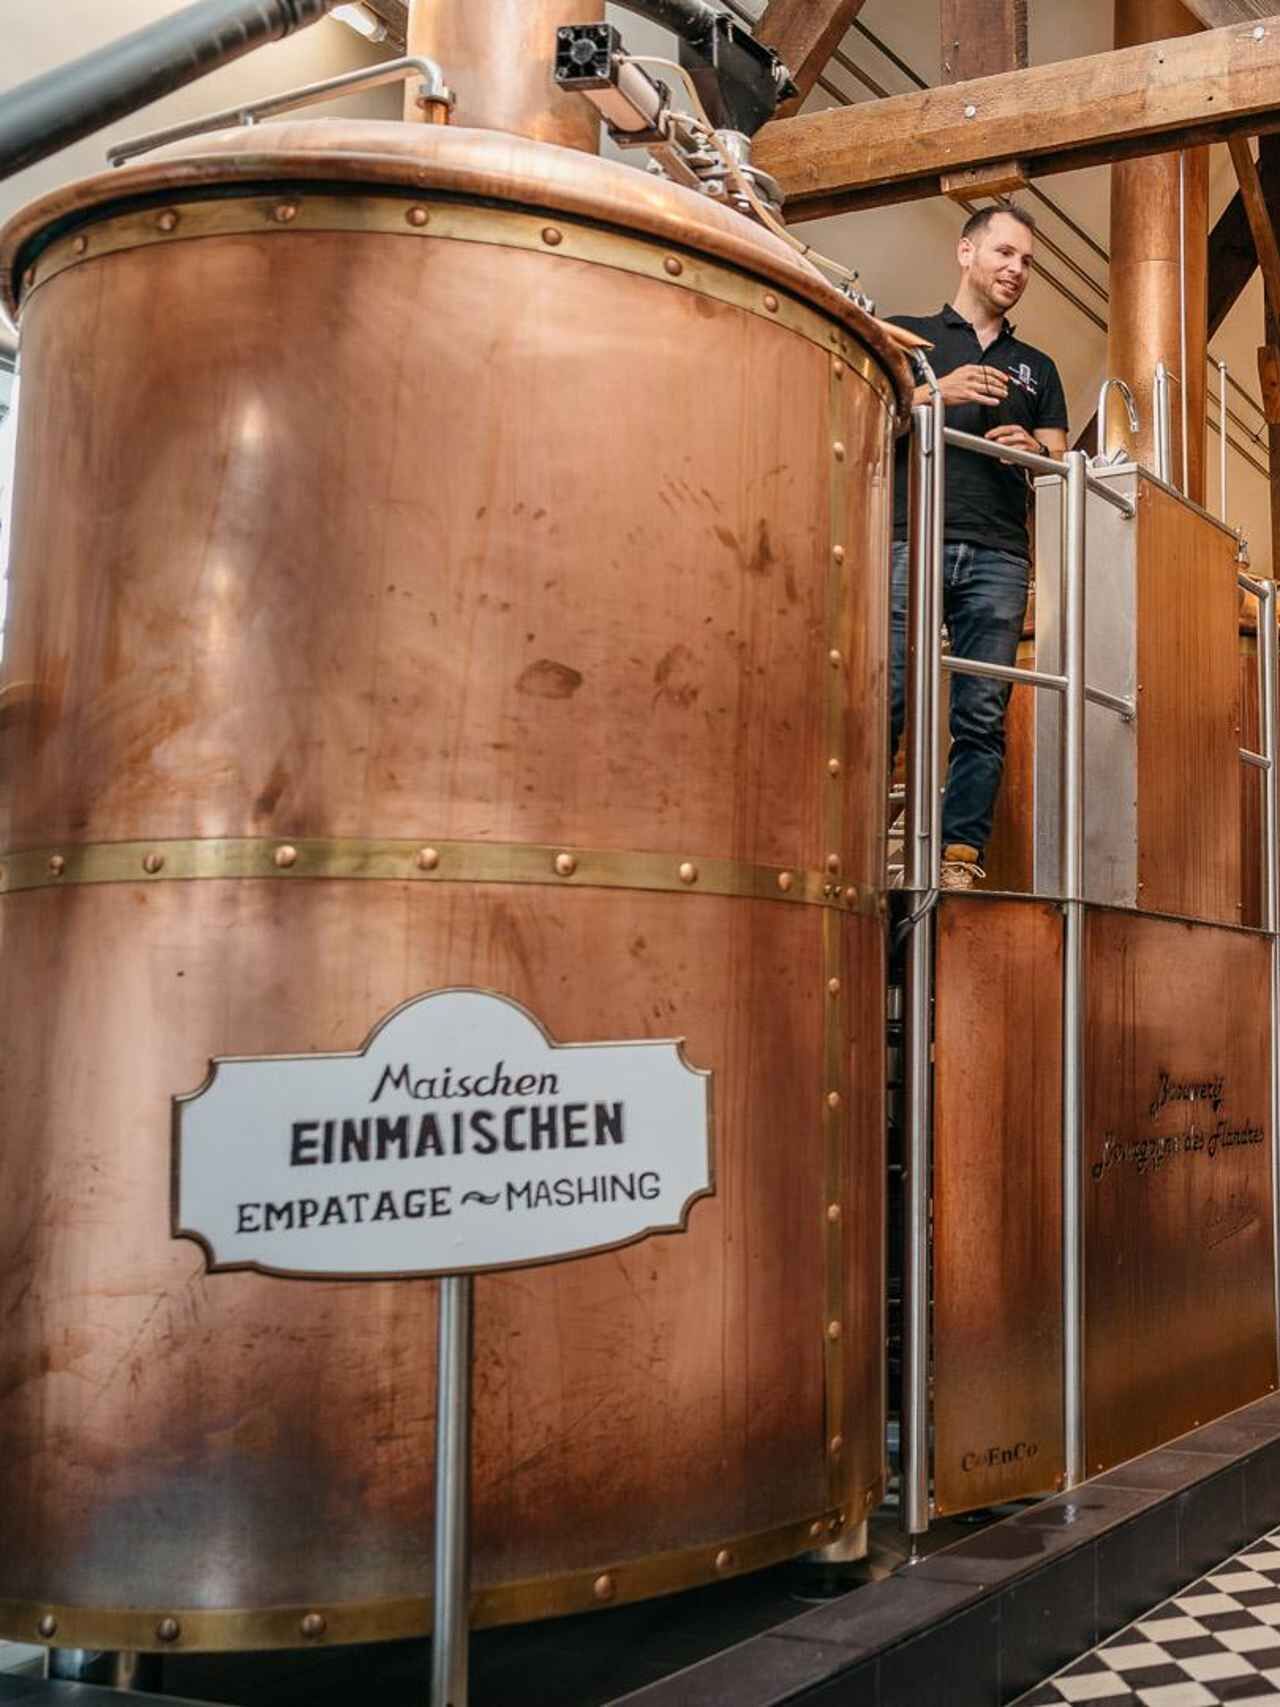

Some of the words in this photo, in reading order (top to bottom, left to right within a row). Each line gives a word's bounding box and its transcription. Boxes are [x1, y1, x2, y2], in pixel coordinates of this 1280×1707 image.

[369, 1061, 559, 1103] Maischen
[290, 1102, 624, 1167] EINMAISCHEN
[236, 1187, 452, 1234] EMPATAGE
[506, 1171, 661, 1211] MASHING
